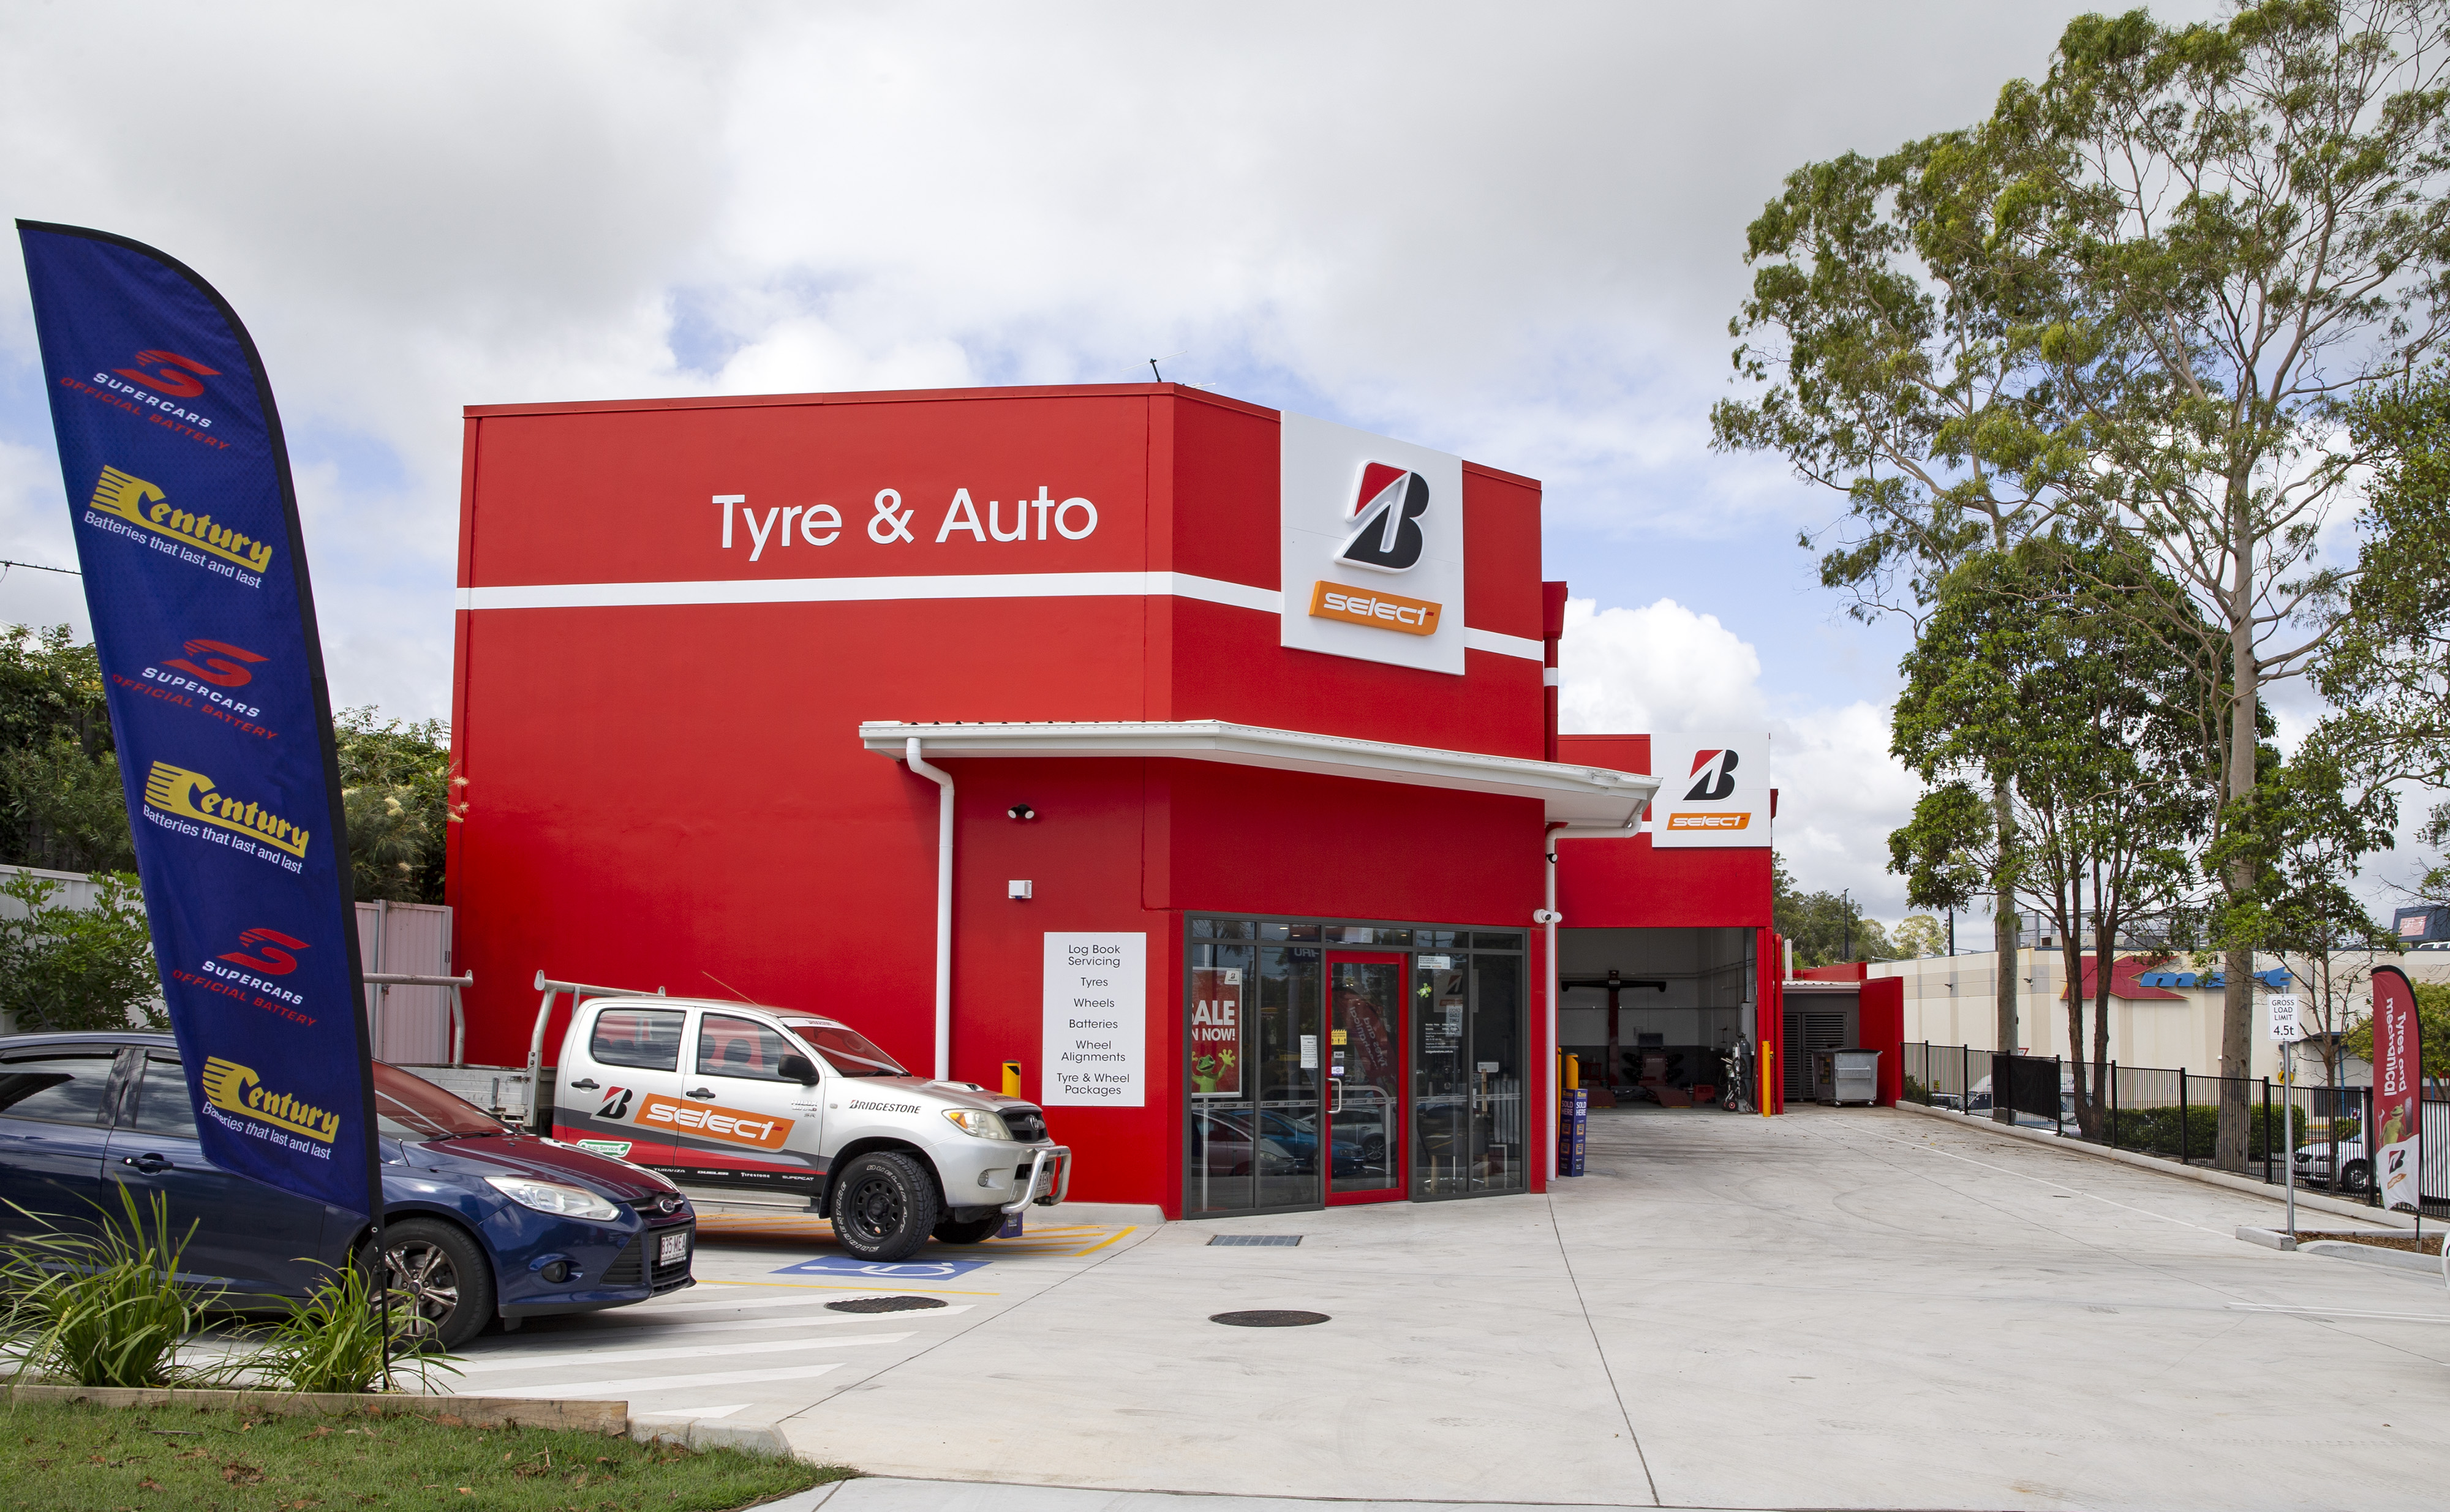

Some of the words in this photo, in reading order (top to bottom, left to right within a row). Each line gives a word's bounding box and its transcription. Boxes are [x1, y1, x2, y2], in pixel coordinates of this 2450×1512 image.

[61, 377, 141, 416] OFFICIAL
[148, 413, 230, 450] BATTERY
[93, 372, 213, 428] SUPERCARS
[89, 465, 273, 573] Century
[712, 494, 842, 562] Tyre
[867, 488, 914, 544] &
[935, 486, 1098, 543] Auto
[84, 510, 147, 544] Batteries
[150, 535, 178, 557] that
[181, 546, 206, 567] last
[208, 556, 236, 577] and
[236, 568, 262, 589] last
[1324, 592, 1428, 626] select
[113, 674, 193, 708] OFFICIAL
[202, 704, 279, 740] BATTERY
[142, 667, 260, 718] SUPERCARS
[145, 761, 309, 858] Century
[1672, 816, 1741, 827] select
[143, 804, 198, 837] Batteries
[202, 826, 230, 846] that
[232, 835, 257, 855] last
[257, 846, 280, 864] and
[281, 856, 303, 874] last
[1068, 944, 1089, 956] Log
[1092, 944, 1121, 954] Book
[1068, 956, 1120, 968] Servicing
[173, 969, 246, 1002] OFFICIAL
[253, 996, 317, 1027] BATTERY
[202, 960, 303, 1005] SUPERCARS
[1080, 977, 1108, 988] Tyres
[1074, 998, 1115, 1007] Wheels
[1192, 999, 1235, 1025] ALE
[1069, 1019, 1118, 1029] Batteries
[1202, 1028, 1235, 1041] NOW!
[2274, 1025, 2294, 1036] 4.5t
[2395, 1012, 2406, 1055] Tyres
[1061, 1052, 1126, 1063] Alignments
[1076, 1040, 1112, 1050] Wheel
[2384, 998, 2397, 1096] mechanical
[1057, 1073, 1079, 1084] Tyre
[1083, 1073, 1091, 1082] &
[1094, 1073, 1129, 1083] Wheel
[1065, 1085, 1121, 1097] Packages
[2399, 1058, 2407, 1092] and
[202, 1056, 339, 1143] Century
[849, 1099, 921, 1114] BRIDGESTONE
[646, 1103, 775, 1140] select
[246, 1122, 270, 1140] that
[270, 1129, 288, 1147] last
[289, 1136, 309, 1153] and
[311, 1142, 331, 1160] last
[866, 1165, 907, 1202] DUELER
[835, 1181, 880, 1252] BRIDGESTONE
